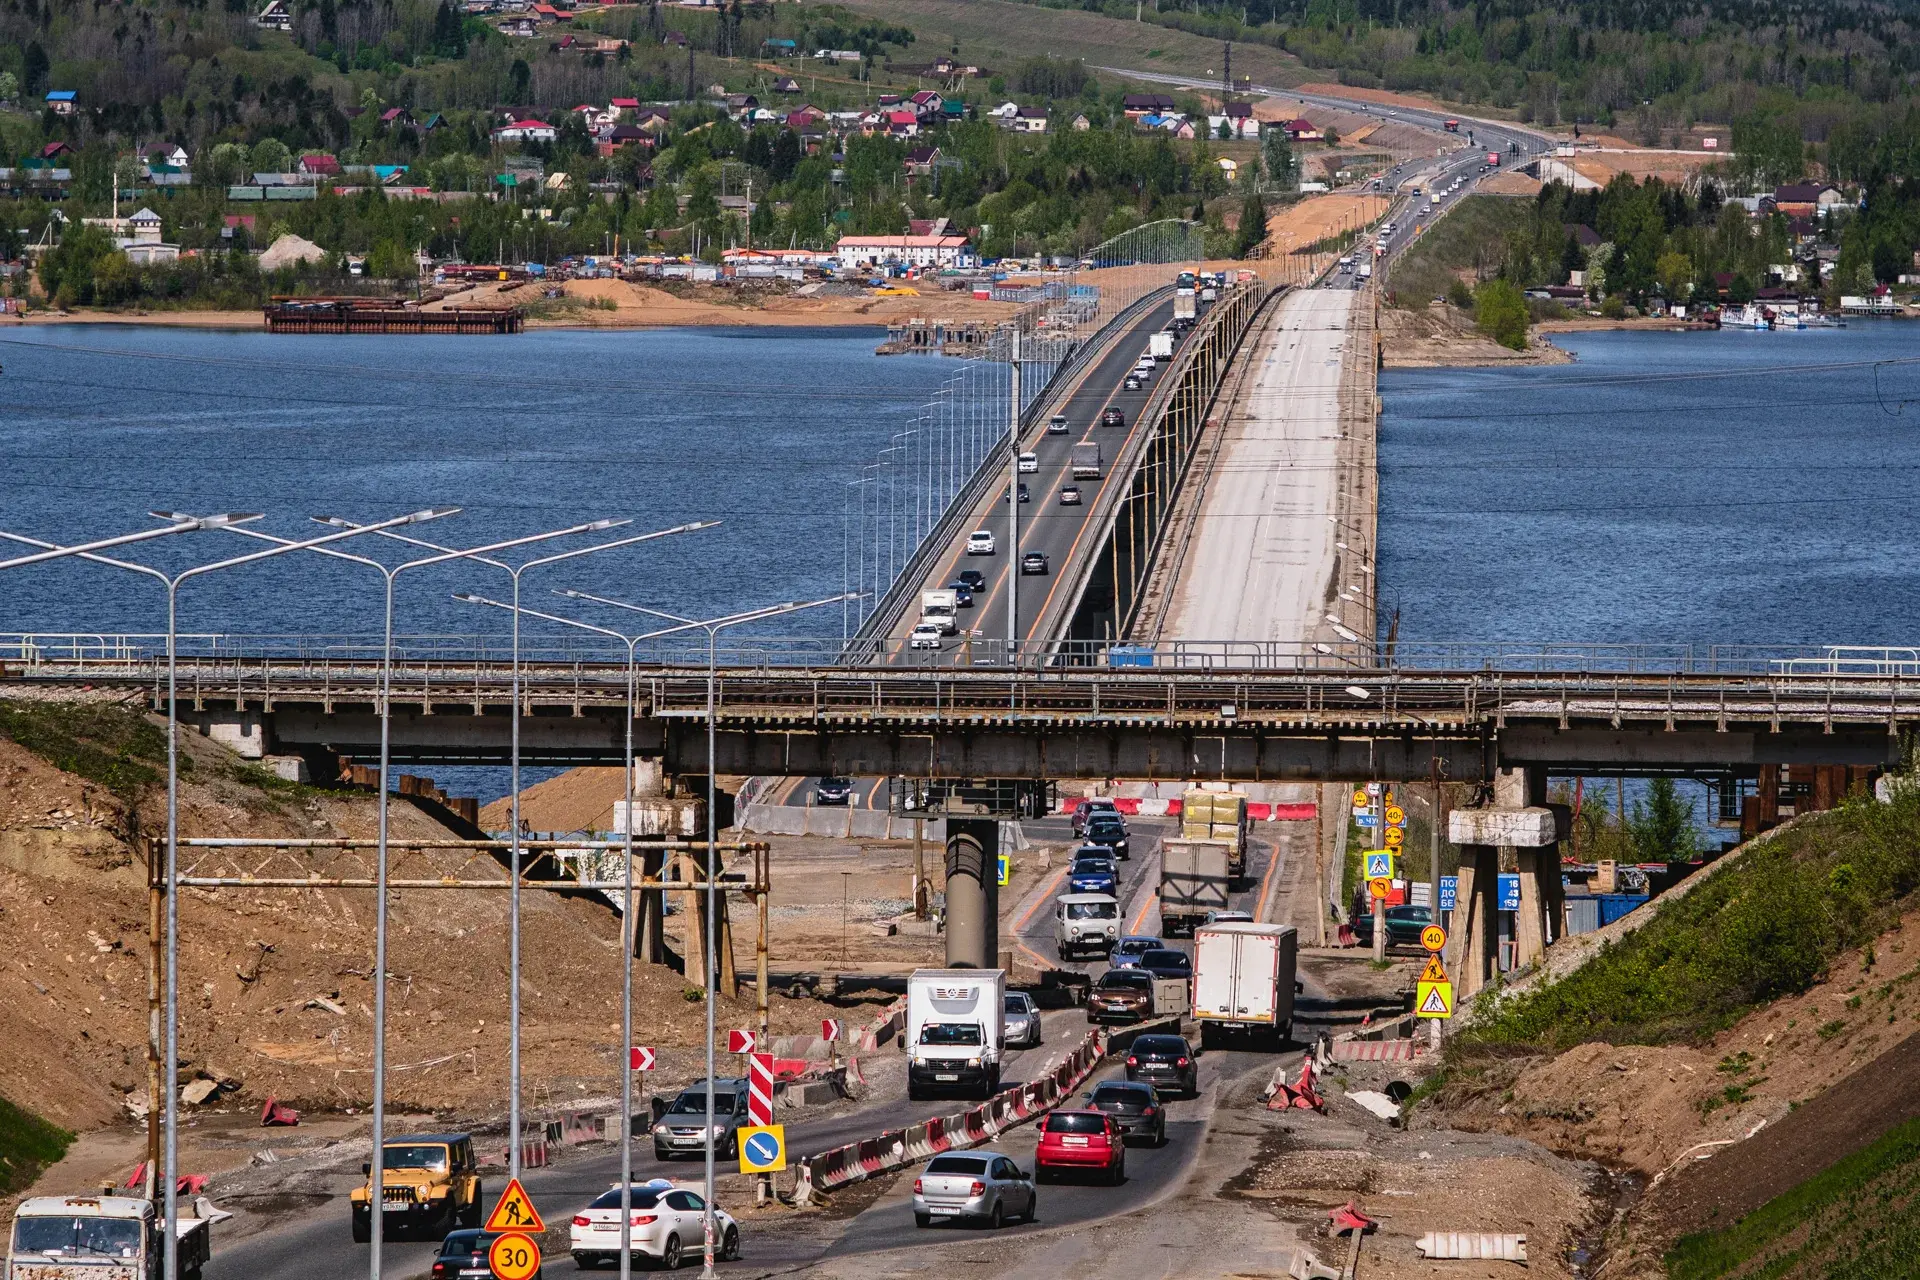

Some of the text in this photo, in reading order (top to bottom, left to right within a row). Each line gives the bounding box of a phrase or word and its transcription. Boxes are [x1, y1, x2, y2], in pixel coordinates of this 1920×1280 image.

[1441, 889, 1456, 898] ДО
[1441, 899, 1454, 907] БЕ
[1426, 933, 1440, 943] 40
[501, 1248, 528, 1267] 30
